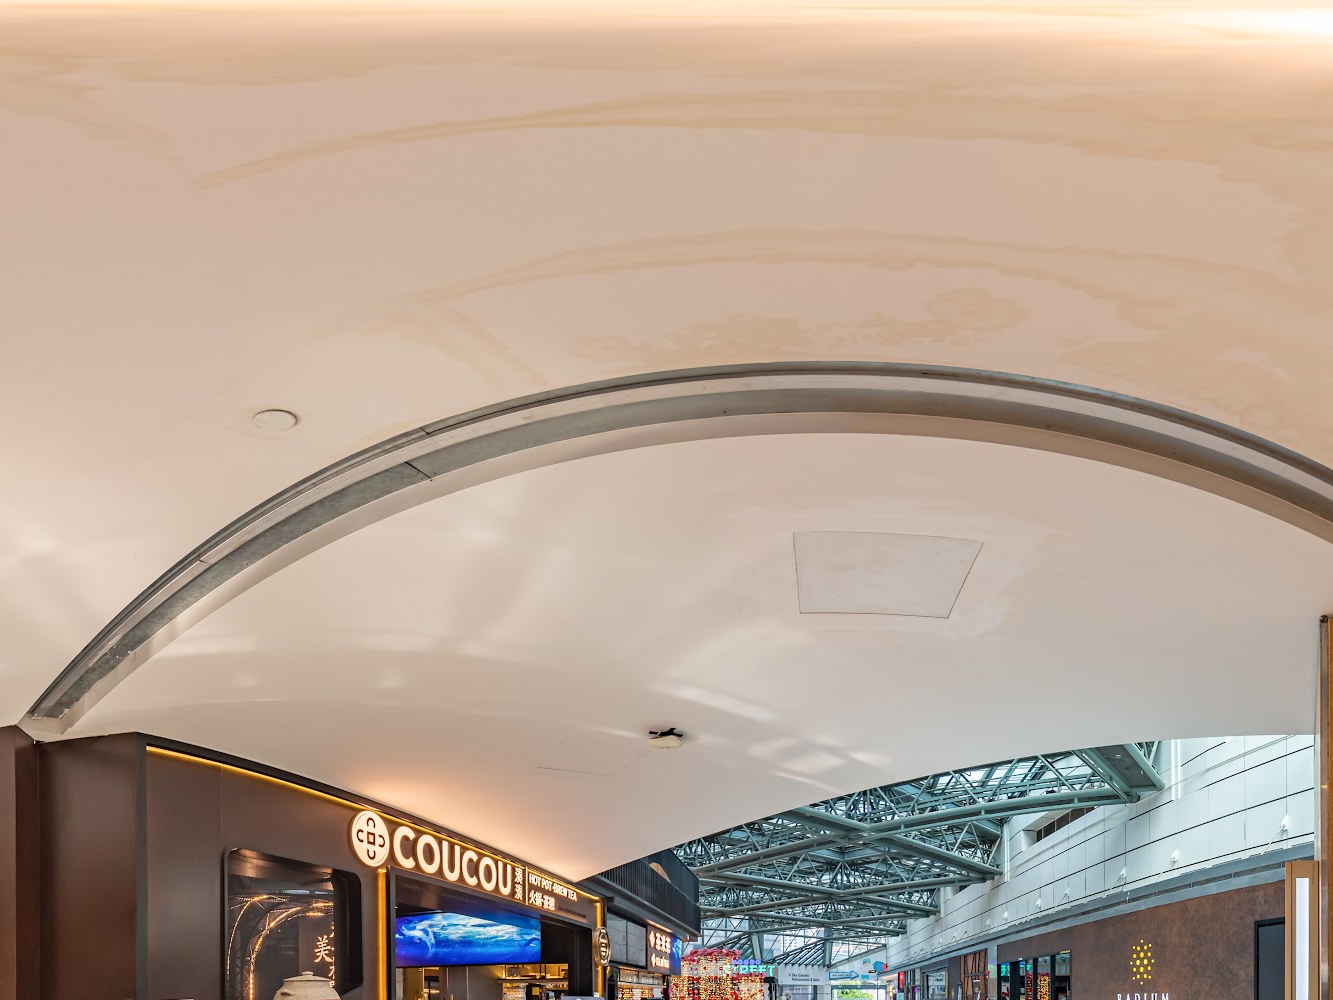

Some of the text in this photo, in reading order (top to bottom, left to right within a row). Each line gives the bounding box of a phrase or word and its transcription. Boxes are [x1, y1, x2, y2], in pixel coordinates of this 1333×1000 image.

[393, 826, 512, 896] COUCOU
[529, 873, 541, 887] HOT
[542, 878, 552, 891] POT
[568, 888, 578, 902] TEA
